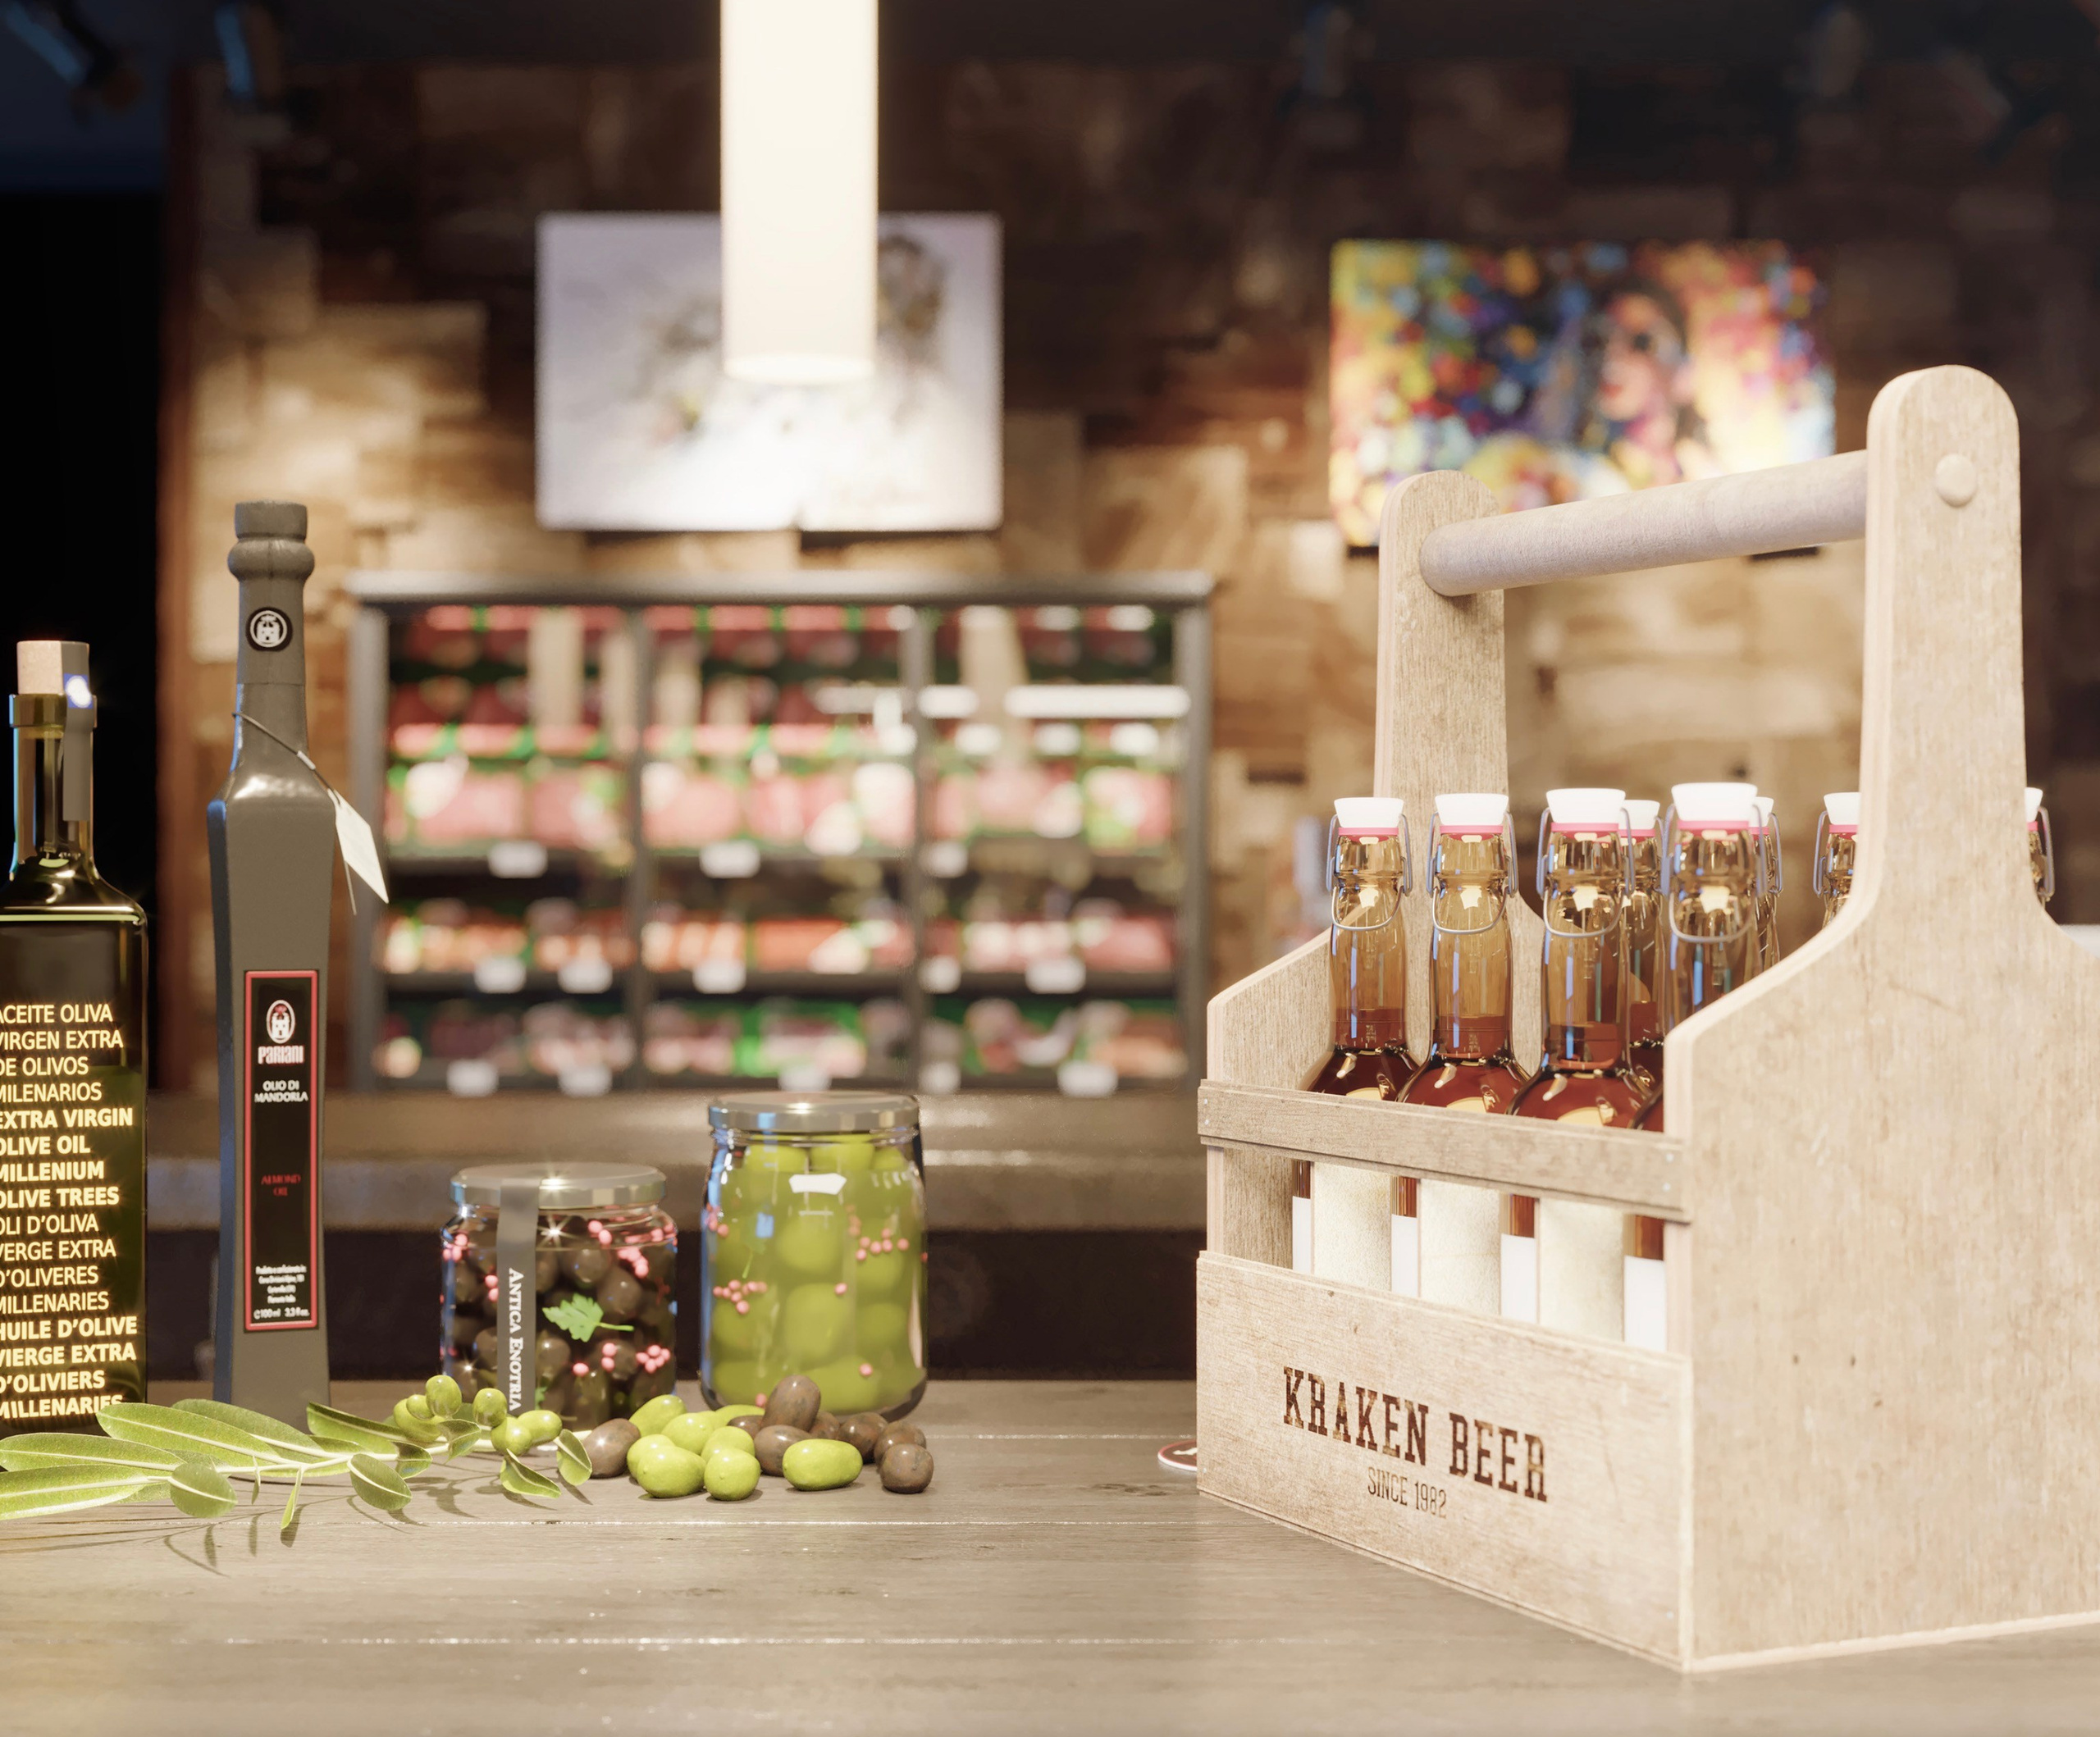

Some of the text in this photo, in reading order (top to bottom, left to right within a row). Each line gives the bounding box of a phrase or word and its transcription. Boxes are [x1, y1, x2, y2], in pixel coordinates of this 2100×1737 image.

[60, 1004, 113, 1024] OLIVA
[66, 1029, 124, 1049] EXTRA
[22, 1055, 89, 1076] OLIVOS
[287, 1079, 300, 1091] DI
[62, 1107, 133, 1128] VIRGIN
[57, 1135, 91, 1155] OIL
[57, 1186, 120, 1207] TREES
[27, 1213, 99, 1234] D'OLIVA
[58, 1238, 116, 1259] EXTRA
[57, 1315, 138, 1338] D'OLIVE
[509, 1268, 524, 1411] ANTICA ENOTRIA
[71, 1342, 137, 1364] EXTRA
[1284, 1365, 1547, 1502] KRAKEN BEER
[1367, 1466, 1447, 1519] SINCE 1982
